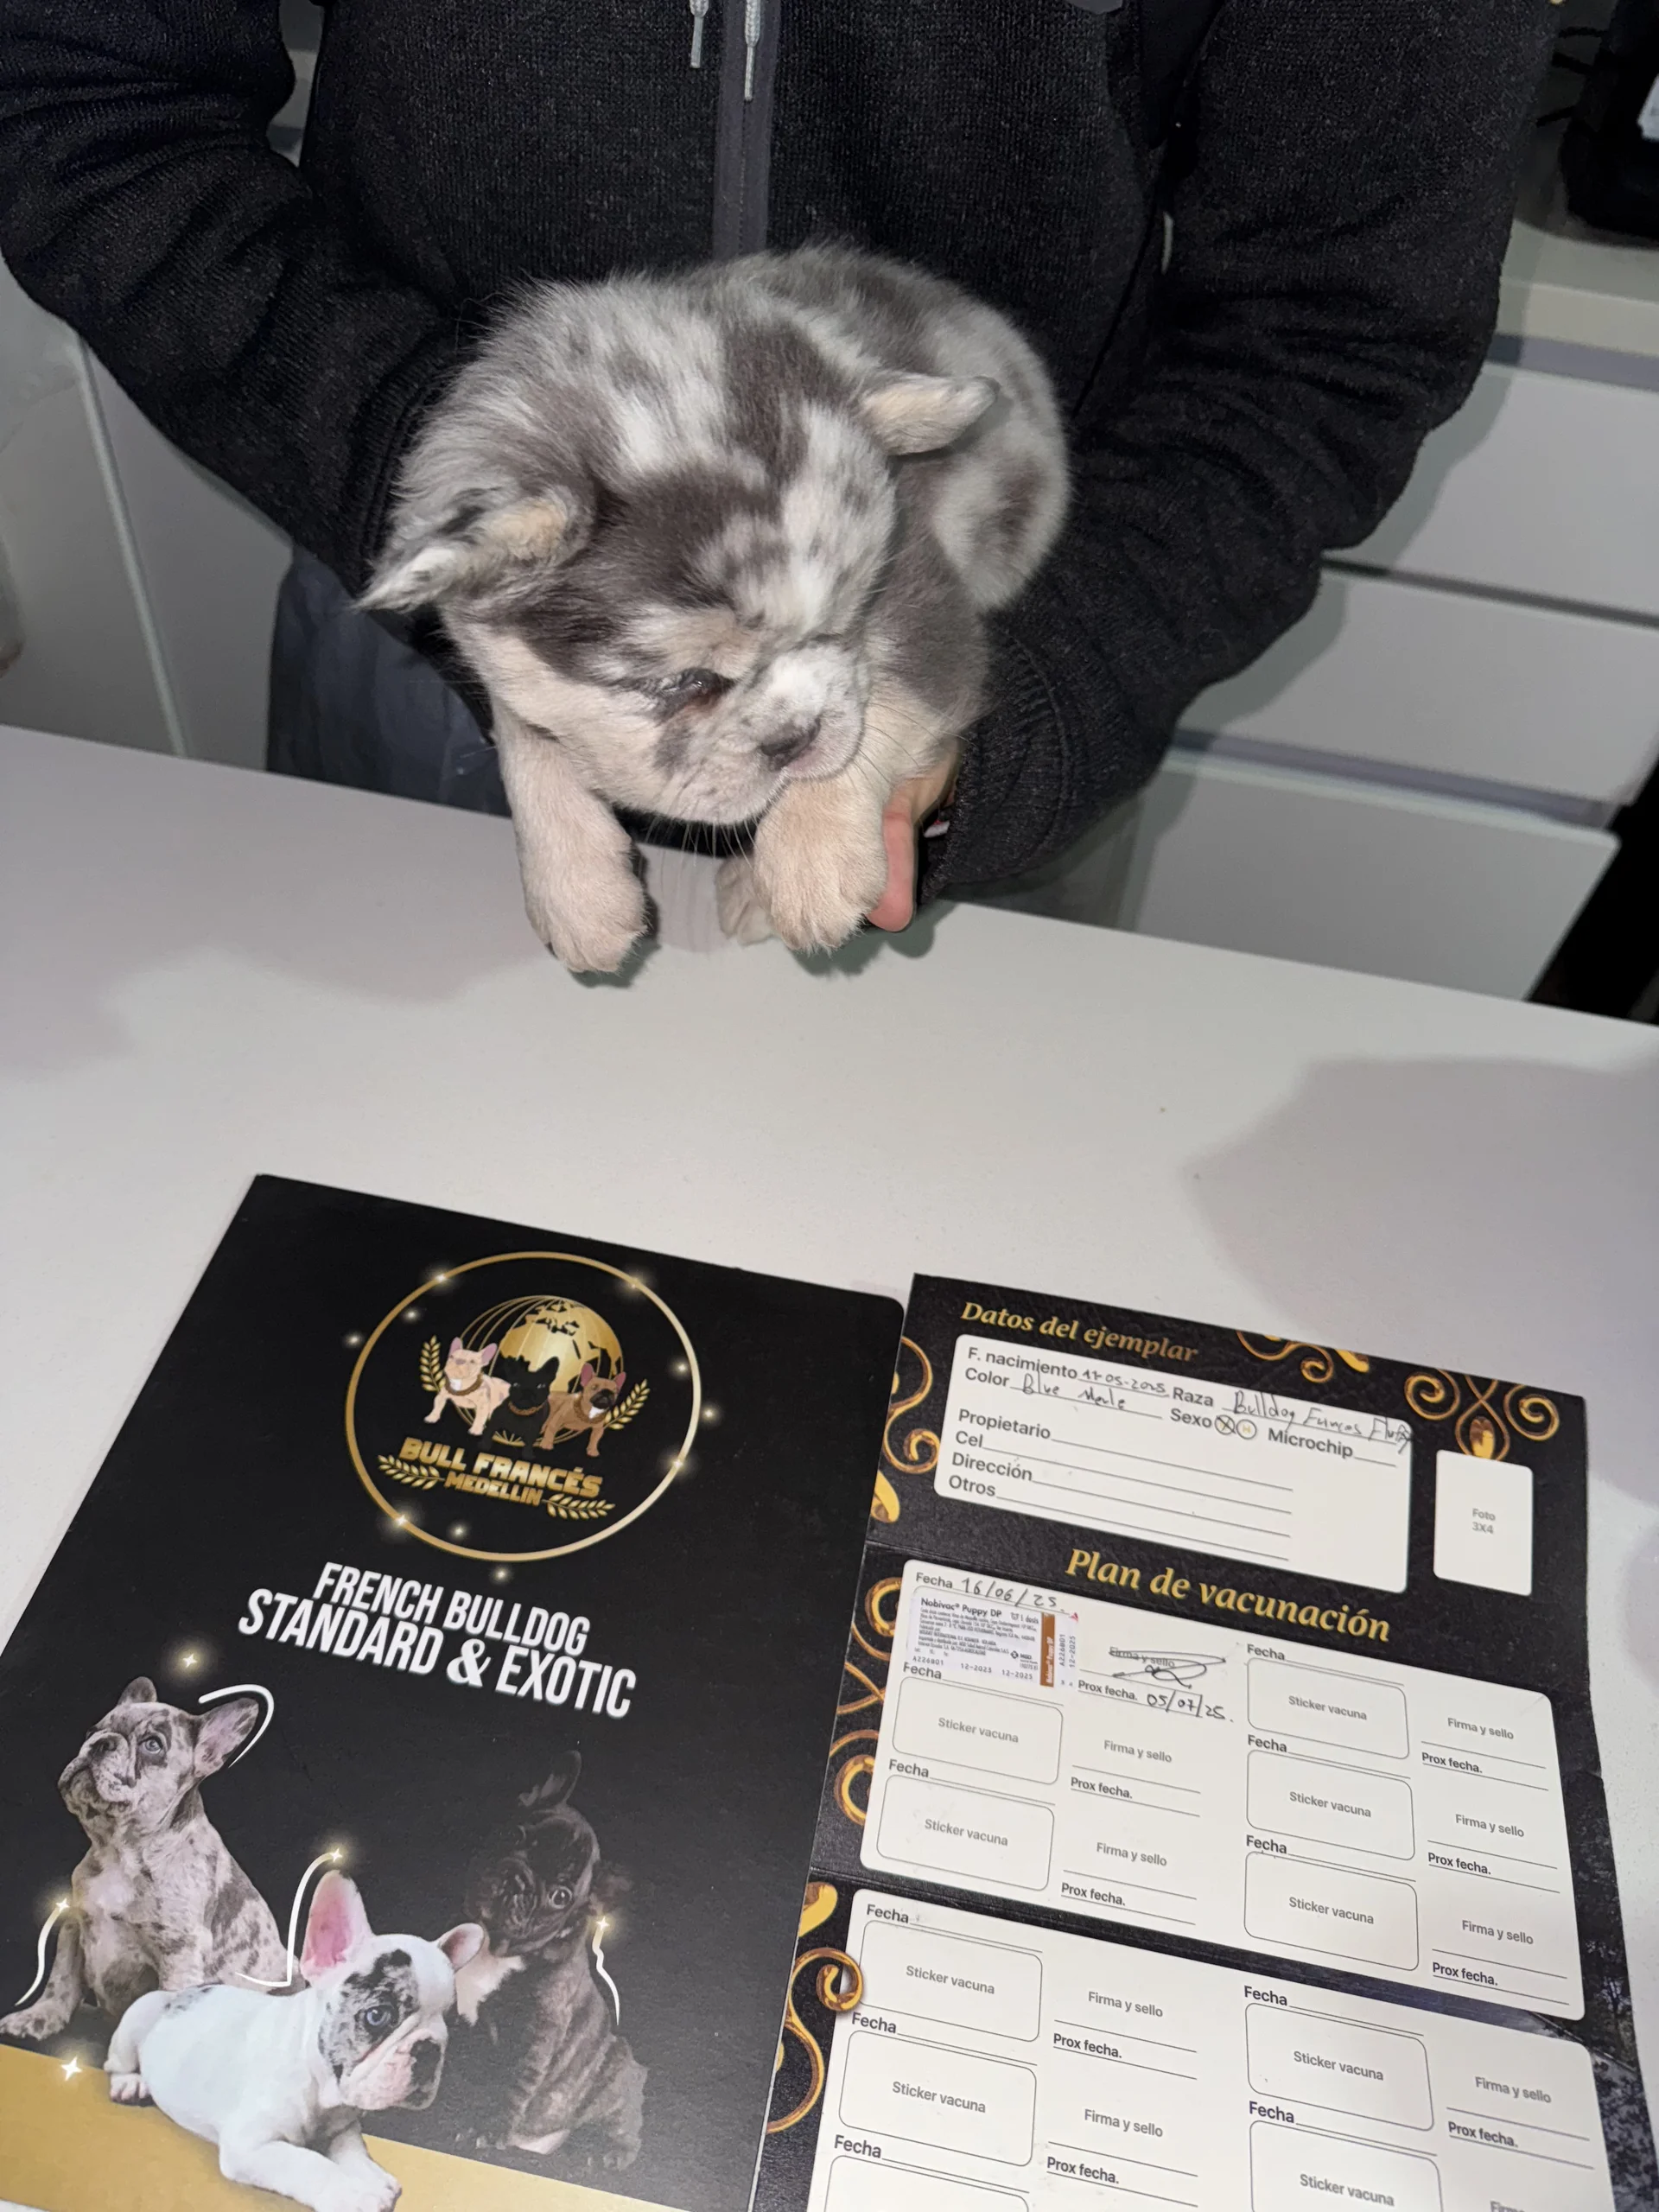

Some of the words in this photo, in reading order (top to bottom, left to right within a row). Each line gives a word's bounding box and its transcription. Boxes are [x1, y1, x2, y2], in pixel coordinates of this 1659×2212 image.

[961, 1301, 1034, 1331] Datos
[1039, 1316, 1078, 1339] del
[1084, 1325, 1198, 1362] ejemplar
[968, 1346, 981, 1361] F.
[986, 1353, 1077, 1379] nacimiento
[965, 1367, 1009, 1387] Color
[1173, 1387, 1214, 1407] Raza
[958, 1408, 1051, 1440] Propietario
[1171, 1408, 1211, 1427] Sexo
[956, 1430, 983, 1448] Cel
[1268, 1427, 1353, 1459] Microchip
[398, 1437, 466, 1471] BULL
[473, 1452, 604, 1499] FRANCÉS
[951, 1452, 1033, 1481] Dirección
[949, 1475, 995, 1497] Otros
[1471, 1508, 1496, 1522] Foto
[916, 1572, 953, 1589] Fecha
[1065, 1548, 1141, 1591] Plan
[1149, 1567, 1191, 1600] de
[1198, 1582, 1390, 1642] vacunación
[312, 1561, 444, 1624] FRENCH
[443, 1590, 590, 1657] BULLDOG
[963, 1604, 988, 1618] Puppy
[990, 1609, 1002, 1618] DP
[238, 1588, 443, 1675] STANDARD
[446, 1638, 492, 1688] &
[495, 1646, 637, 1719] EXOTIC
[1248, 1643, 1285, 1661] Fecha
[903, 1662, 942, 1681] Fecha
[1077, 1679, 1103, 1693] Prox
[1105, 1685, 1138, 1700] fecha.
[1289, 1695, 1326, 1712] Sticker
[1328, 1705, 1367, 1720] vacuna
[938, 1717, 977, 1735] Sticker
[979, 1727, 1019, 1744] vacuna
[1447, 1717, 1478, 1732] Firma
[1479, 1725, 1487, 1736] y
[1489, 1725, 1514, 1739] sello
[1104, 1739, 1135, 1756] Firma
[1136, 1747, 1144, 1758] y
[1146, 1747, 1173, 1764] sello
[1248, 1734, 1287, 1753] Fecha
[888, 1758, 929, 1778] Fecha
[1421, 1751, 1446, 1766] Prox
[1448, 1757, 1483, 1774] fecha.
[1071, 1777, 1096, 1793] Prox
[1098, 1782, 1133, 1799] fecha.
[1289, 1791, 1328, 1808] Sticker
[1331, 1802, 1371, 1817] vacuna
[925, 1819, 964, 1837] Sticker
[966, 1830, 1008, 1847] vacuna
[1455, 1814, 1486, 1830] Firma
[1489, 1821, 1497, 1834] y
[1498, 1821, 1524, 1837] sello
[1096, 1842, 1128, 1859] Firma
[1130, 1851, 1138, 1862] y
[1140, 1850, 1167, 1866] sello
[1246, 1834, 1287, 1854] Fecha
[1427, 1852, 1453, 1867] Prox
[1456, 1857, 1491, 1875] fecha.
[1061, 1882, 1087, 1899] Prox
[1090, 1887, 1126, 1906] fecha.
[867, 1904, 909, 1924] Fecha
[1289, 1897, 1330, 1915] Sticker
[1332, 1908, 1374, 1924] vacuna
[1462, 1920, 1495, 1937] Firma
[1497, 1929, 1504, 1941] y
[1507, 1928, 1534, 1945] sello
[906, 1965, 949, 1985] Sticker
[951, 1976, 995, 1994] vacuna
[1433, 1962, 1459, 1978] Prox
[1461, 1967, 1498, 1986] fecha.
[1088, 1991, 1122, 2010] Firma
[1125, 2001, 1133, 2014] y
[1135, 1999, 1163, 2018] sello
[1244, 1985, 1287, 2006] Fecha
[852, 2011, 897, 2034] Fecha
[1053, 2033, 1081, 2050] Prox
[1084, 2038, 1122, 2059] fecha.
[1294, 2050, 1337, 2070] Sticker
[1339, 2063, 1383, 2081] vacuna
[893, 2081, 937, 2102] Sticker
[940, 2094, 986, 2113] vacuna
[1475, 2076, 1510, 2095] Firma
[1512, 2086, 1520, 2099] y
[1522, 2085, 1552, 2105] sello
[1084, 2108, 1120, 2128] Firma
[1122, 2119, 1131, 2133] y
[1134, 2119, 1163, 2138] sello
[1249, 2101, 1294, 2124] Fecha
[835, 2134, 881, 2158] Fecha
[1448, 2121, 1477, 2139] Prox
[1479, 2127, 1518, 2148] fecha.
[1047, 2157, 1076, 2175] Prox
[1078, 2163, 1120, 2184] fecha.
[1300, 2173, 1344, 2196] Sticker
[1347, 2187, 1395, 2208] vacuna
